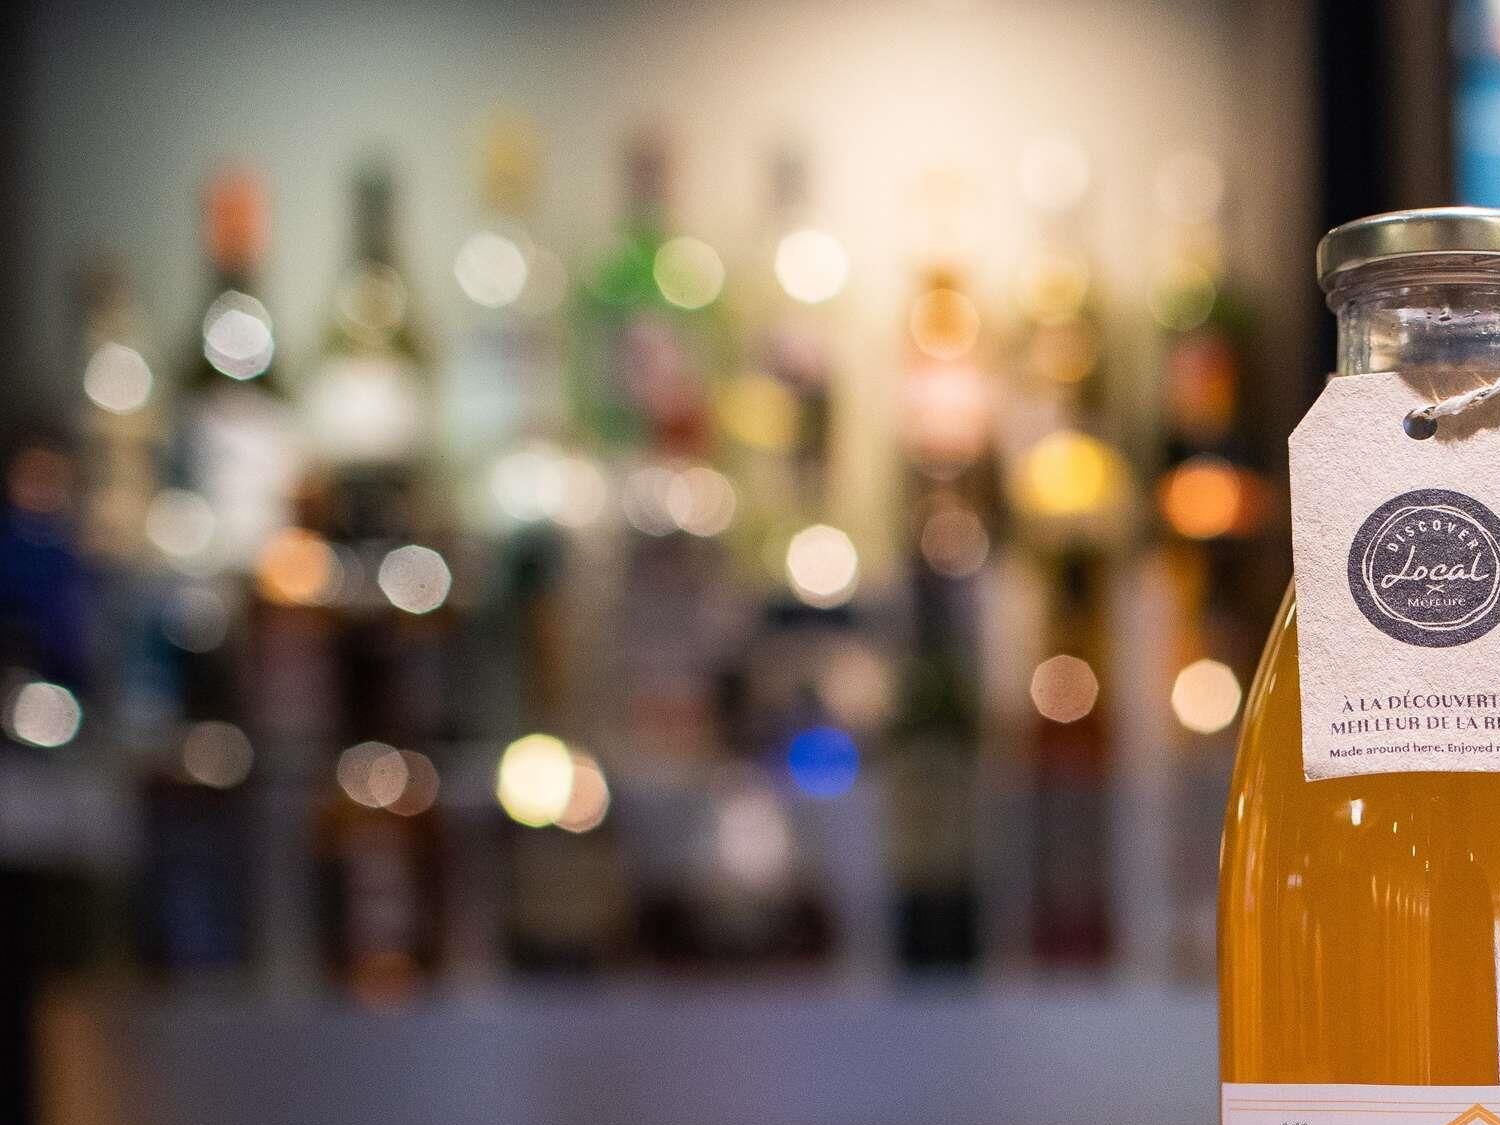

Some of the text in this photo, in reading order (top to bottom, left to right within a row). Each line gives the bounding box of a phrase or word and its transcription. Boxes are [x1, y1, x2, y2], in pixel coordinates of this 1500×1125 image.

[1386, 519, 1479, 552] DISCOVER
[1381, 545, 1490, 588] Local
[1342, 694, 1354, 713] À
[1360, 698, 1382, 711] LA
[1331, 716, 1420, 735] MEILLEUR
[1426, 716, 1450, 730] DE
[1456, 716, 1478, 730] LA
[1329, 746, 1363, 758] Made
[1366, 743, 1410, 754] around
[1413, 742, 1444, 752] here.
[1448, 743, 1493, 754] Enjoyed
